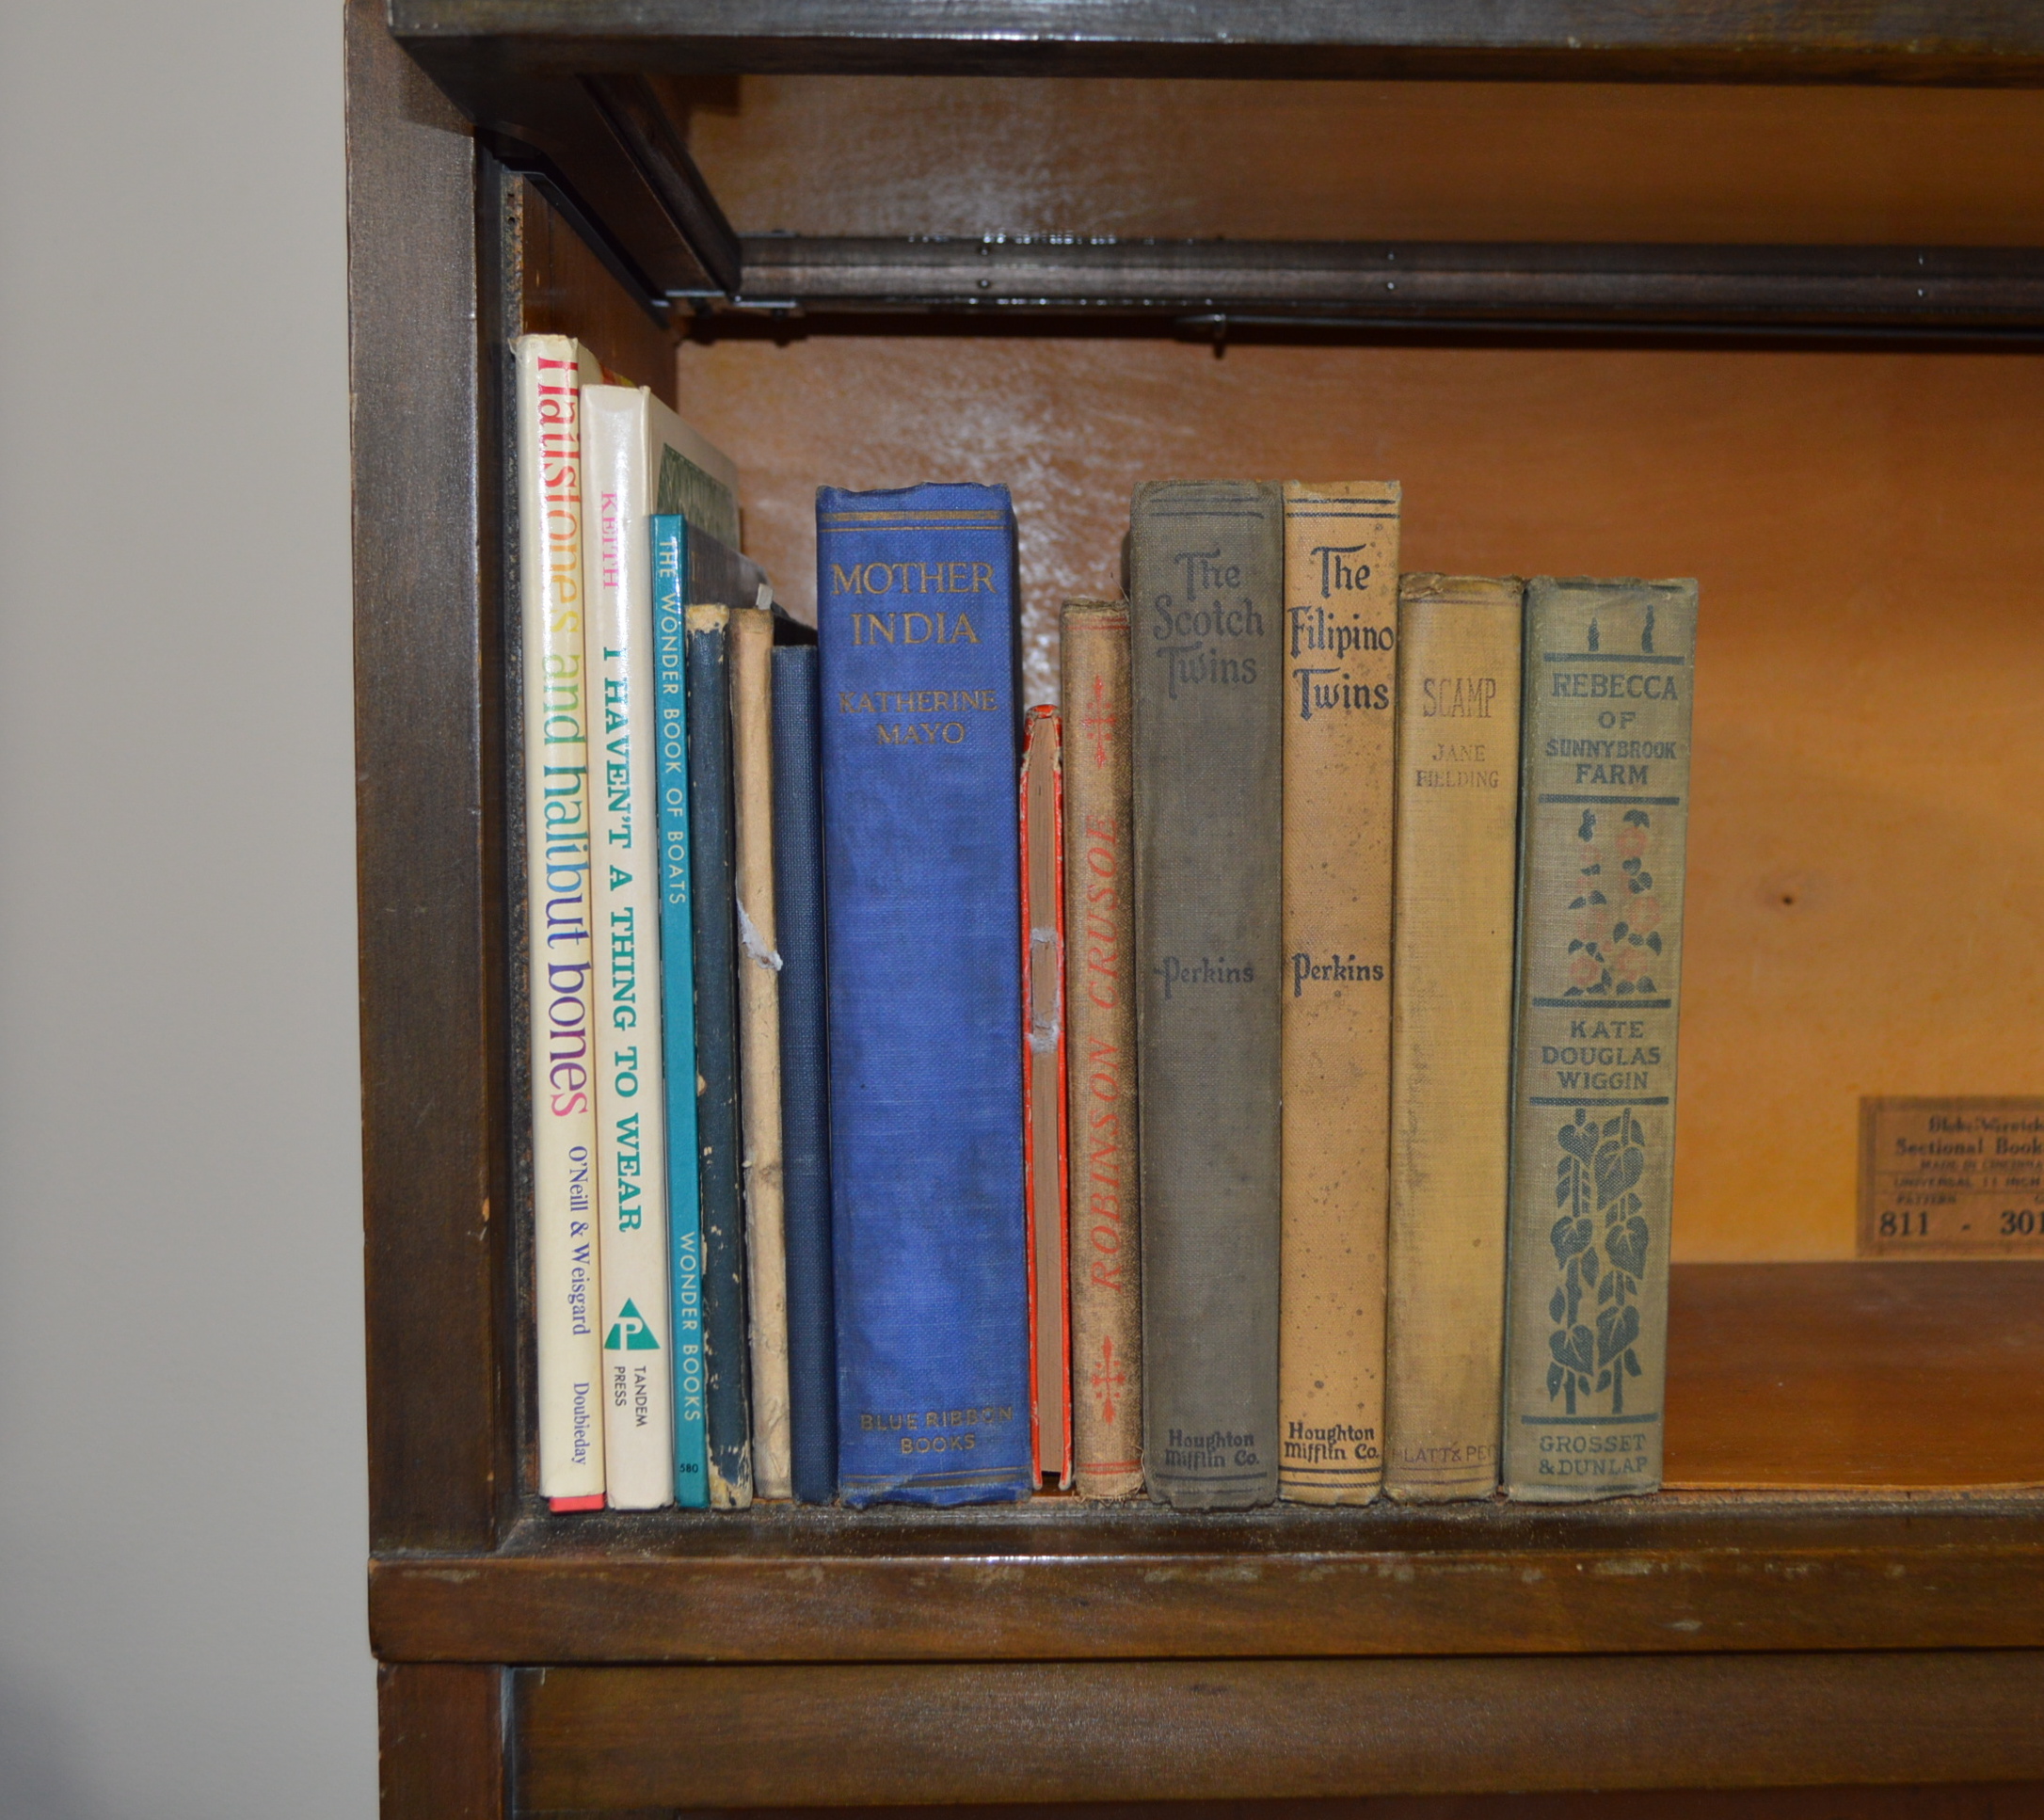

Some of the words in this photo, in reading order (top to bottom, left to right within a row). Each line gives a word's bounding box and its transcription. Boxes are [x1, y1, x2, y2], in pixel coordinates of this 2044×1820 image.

[537, 356, 582, 634] Hailstones
[600, 491, 620, 590] KEITH
[659, 541, 677, 579] THE
[832, 561, 998, 595] MOTHER
[1174, 548, 1241, 602] The
[1310, 543, 1371, 599] The
[851, 612, 982, 646] INDIA
[1152, 593, 1266, 641] Scotch
[1286, 604, 1395, 660] Filipino
[603, 647, 628, 662] I
[661, 592, 680, 694] WONDER
[1156, 640, 1258, 701] Twins
[1552, 672, 1678, 700] REBECCA
[542, 653, 586, 745] and
[838, 690, 998, 712] KATHERINE
[1291, 666, 1390, 722] Twins
[1423, 678, 1496, 719] SCAMP
[876, 722, 966, 744] MAYO
[1597, 710, 1636, 729] OF
[663, 708, 681, 774] BOOK
[1431, 742, 1486, 763] JANE
[1544, 738, 1677, 759] SUNNYBROOK
[604, 677, 632, 849] HAVEN'T
[1415, 769, 1500, 789] FIELDING
[1575, 763, 1648, 785] FARM
[665, 788, 684, 819] OF
[543, 764, 590, 950] halibut
[667, 830, 686, 904] BOATS
[610, 864, 633, 892] A
[1086, 814, 1120, 1010] CRUSOE
[611, 906, 636, 1031] THING
[1153, 955, 1255, 1000] Perkins
[1290, 951, 1385, 998] Perkins
[548, 961, 592, 1118] bones
[1570, 1020, 1644, 1039] KATE
[615, 1046, 639, 1098] TO
[1542, 1046, 1661, 1065] DOUGLAS
[1557, 1071, 1649, 1090] WIGGIN
[616, 1112, 642, 1234] WEAR
[1088, 1036, 1122, 1293] ROBINSON
[569, 1221, 589, 1238] &
[1879, 1209, 1928, 1236] 811
[567, 1242, 591, 1336] Weisgard
[679, 1231, 698, 1331] WONDER
[614, 1365, 628, 1408] PRESS
[633, 1365, 648, 1428] TANDEM
[682, 1344, 701, 1422] BOOKS
[860, 1413, 919, 1432] BLUE
[925, 1406, 1014, 1429] RIBBON
[1287, 1421, 1375, 1446] Houghton
[900, 1433, 976, 1455] BOOKS
[1164, 1447, 1226, 1471] Mifflin
[1234, 1448, 1260, 1466] Co.
[1168, 1429, 1256, 1454] Houghton
[1284, 1442, 1349, 1464] Mifflin
[1353, 1443, 1380, 1461] Co.
[1540, 1433, 1646, 1454] GROSSET
[679, 1462, 699, 1474] 580
